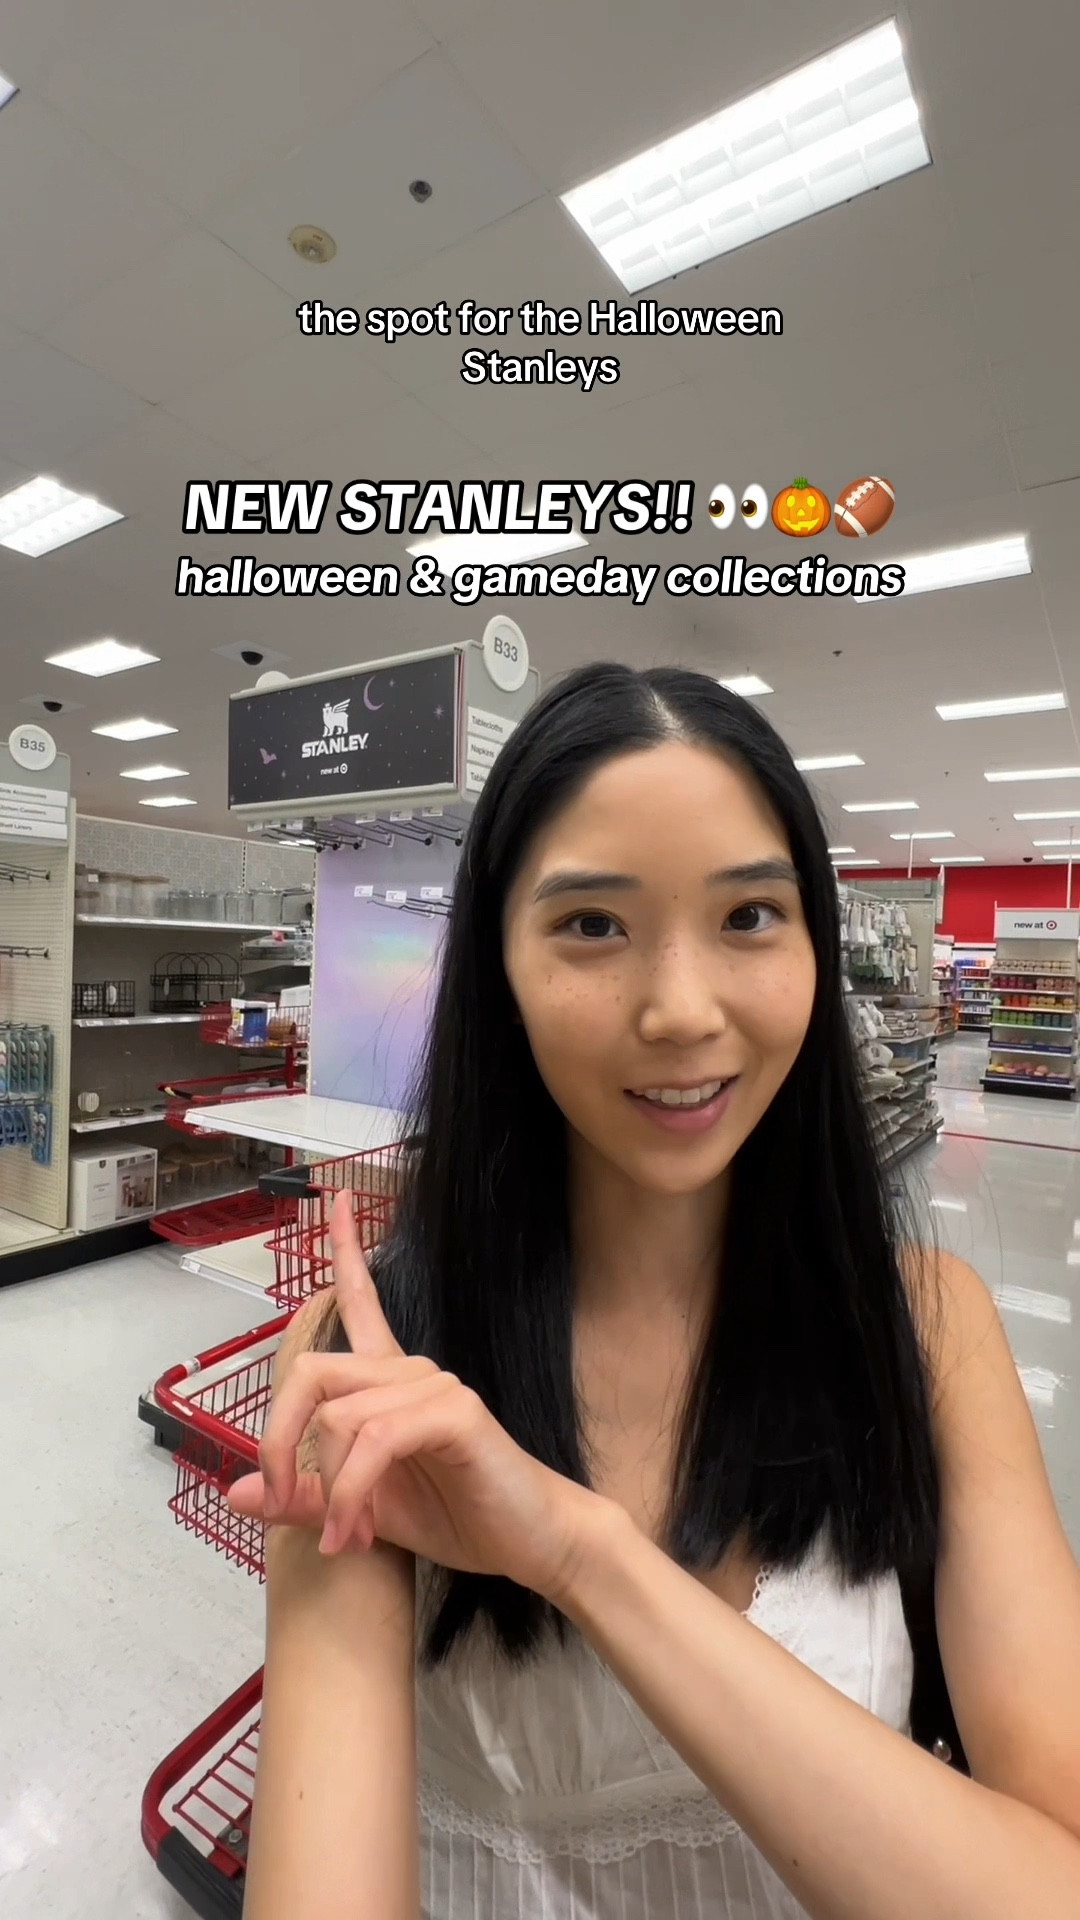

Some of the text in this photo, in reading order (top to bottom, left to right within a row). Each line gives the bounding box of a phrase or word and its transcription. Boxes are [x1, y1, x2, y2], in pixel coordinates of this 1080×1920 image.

[494, 636, 519, 662] B33
[20, 738, 46, 753] B35
[301, 732, 369, 759] STANLEY
[1034, 921, 1044, 929] at
